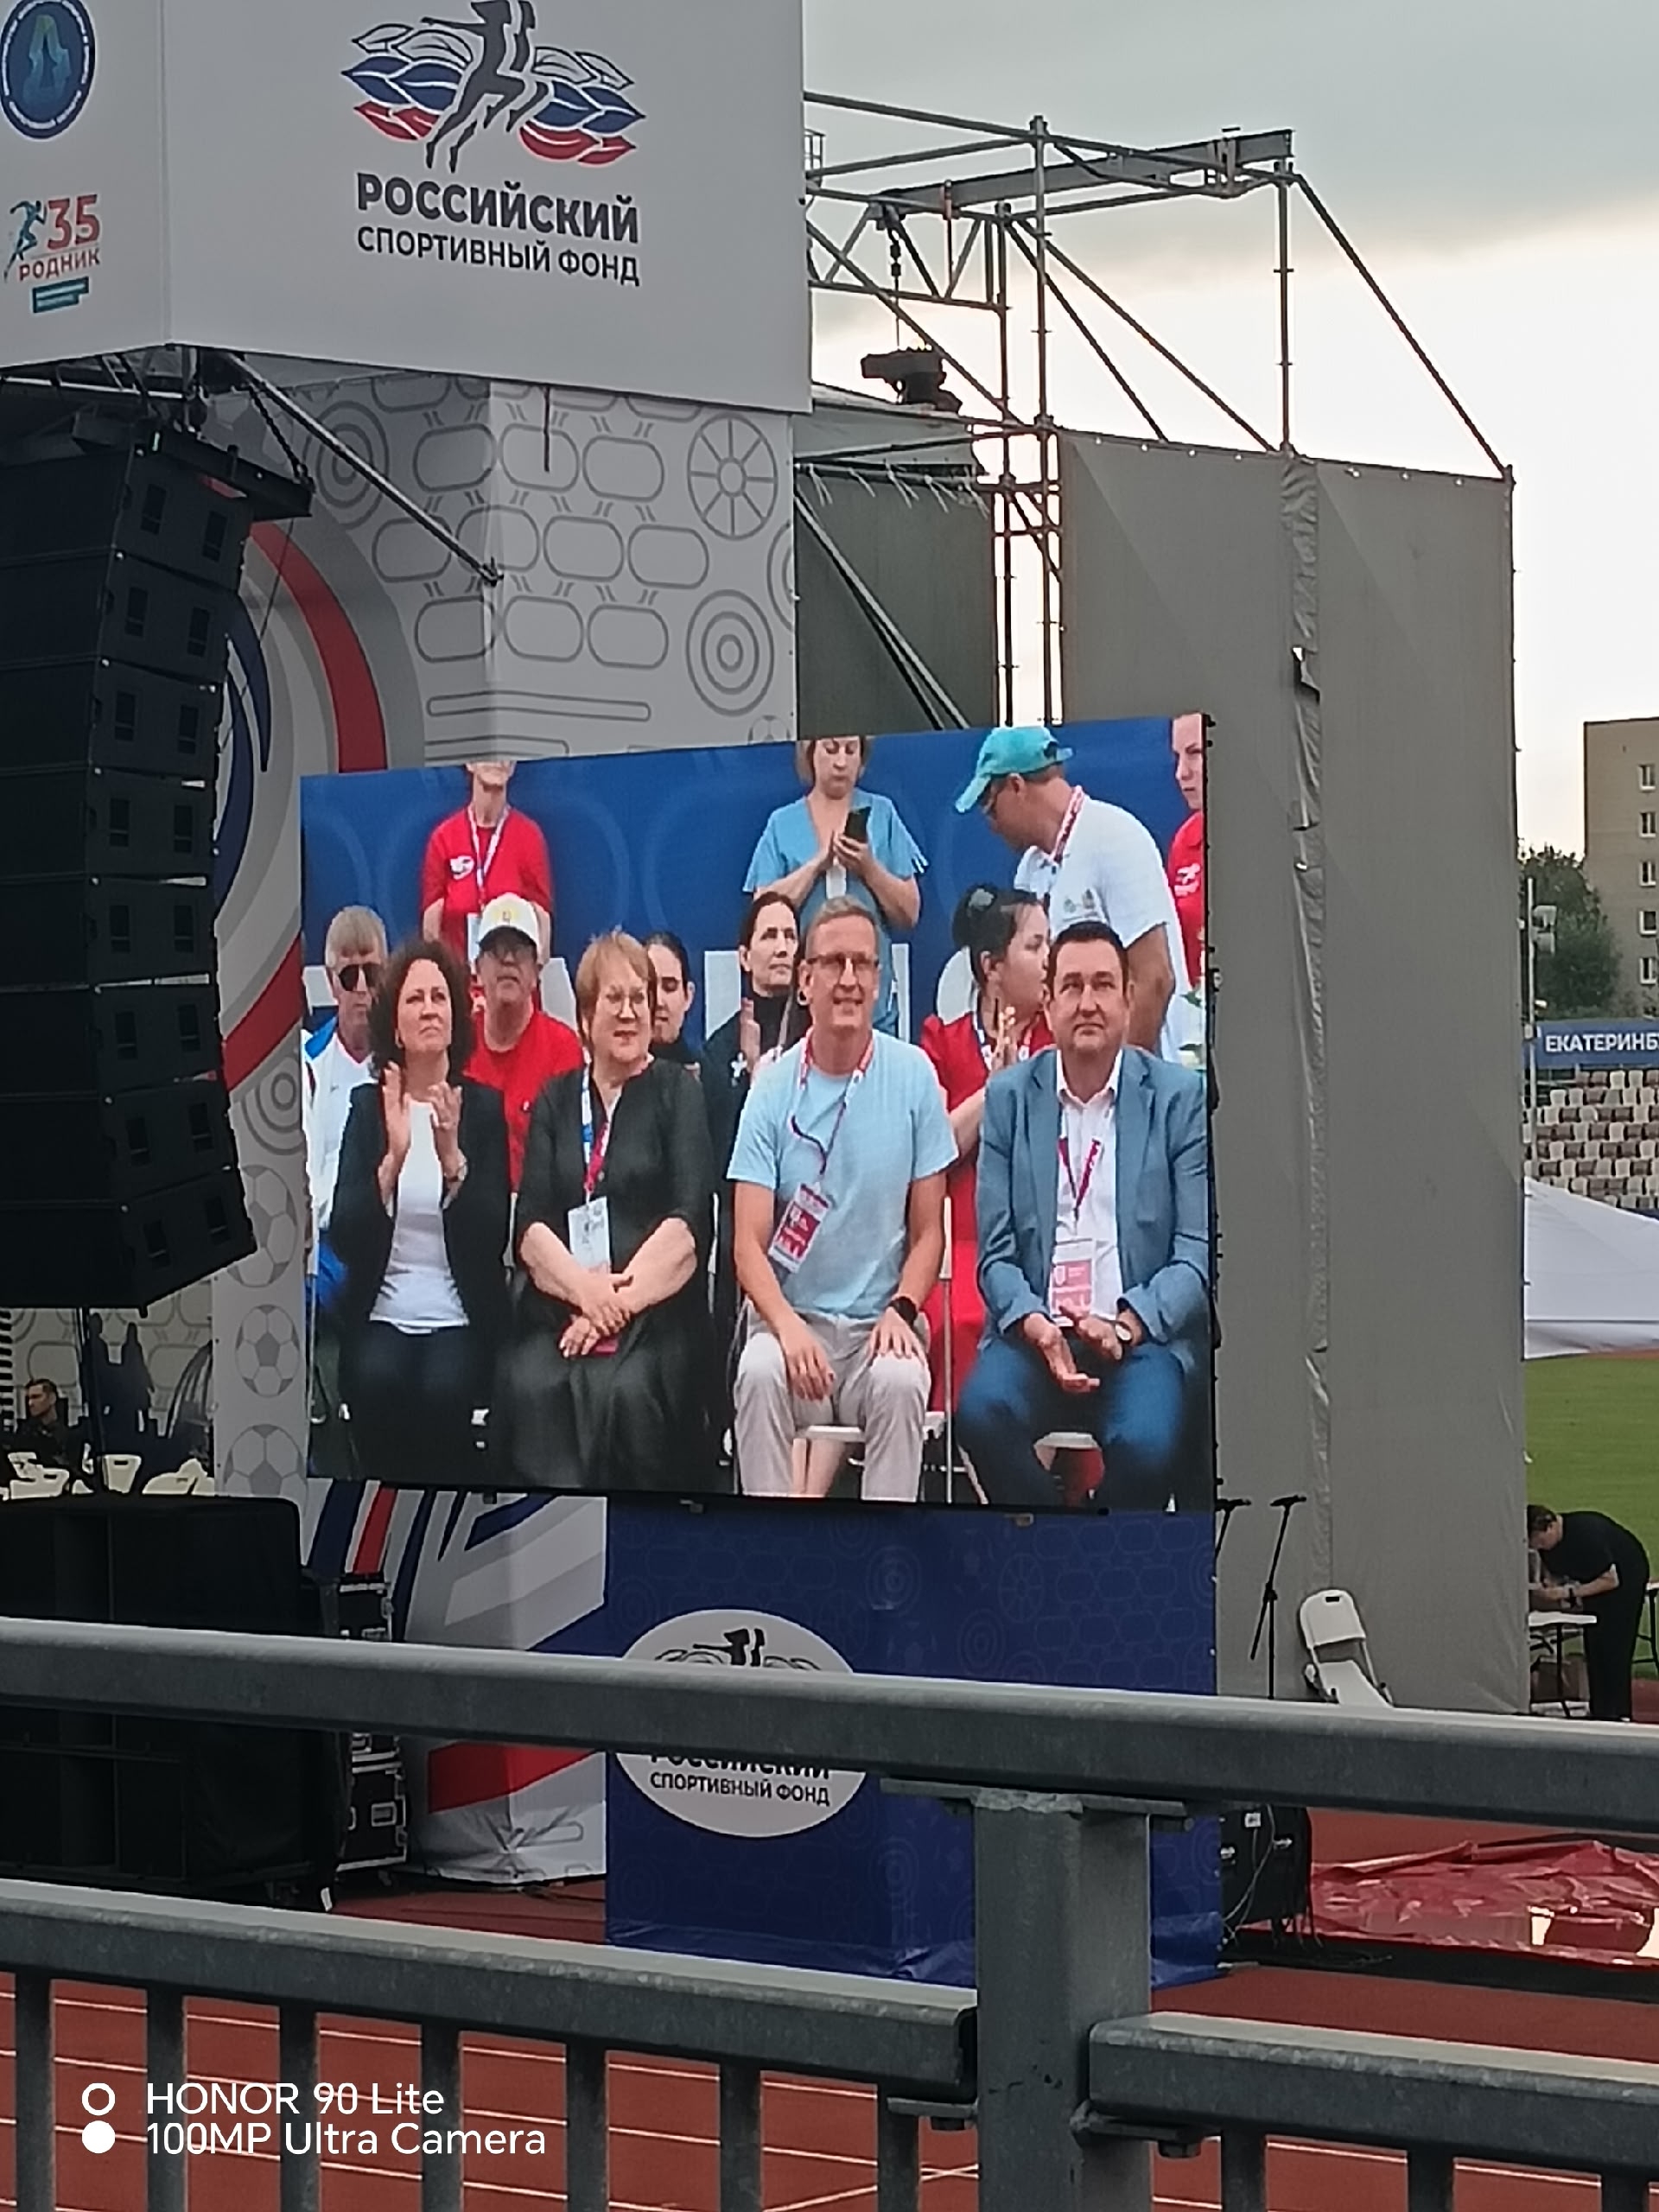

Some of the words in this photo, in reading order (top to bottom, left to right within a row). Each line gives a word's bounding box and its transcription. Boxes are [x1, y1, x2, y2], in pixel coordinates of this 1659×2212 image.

[47, 194, 100, 250] 35
[357, 172, 639, 244] РОССИЙСКИЙ
[19, 248, 101, 281] РОДНИК
[357, 226, 550, 272] СПОРТИВНЫЙ
[558, 249, 640, 287] ФОНД
[1545, 1032, 1659, 1052] ЕКАТЕРИНБ
[650, 1771, 772, 1798] СПОРТИВНЫЙ
[776, 1783, 830, 1808] ФОНД
